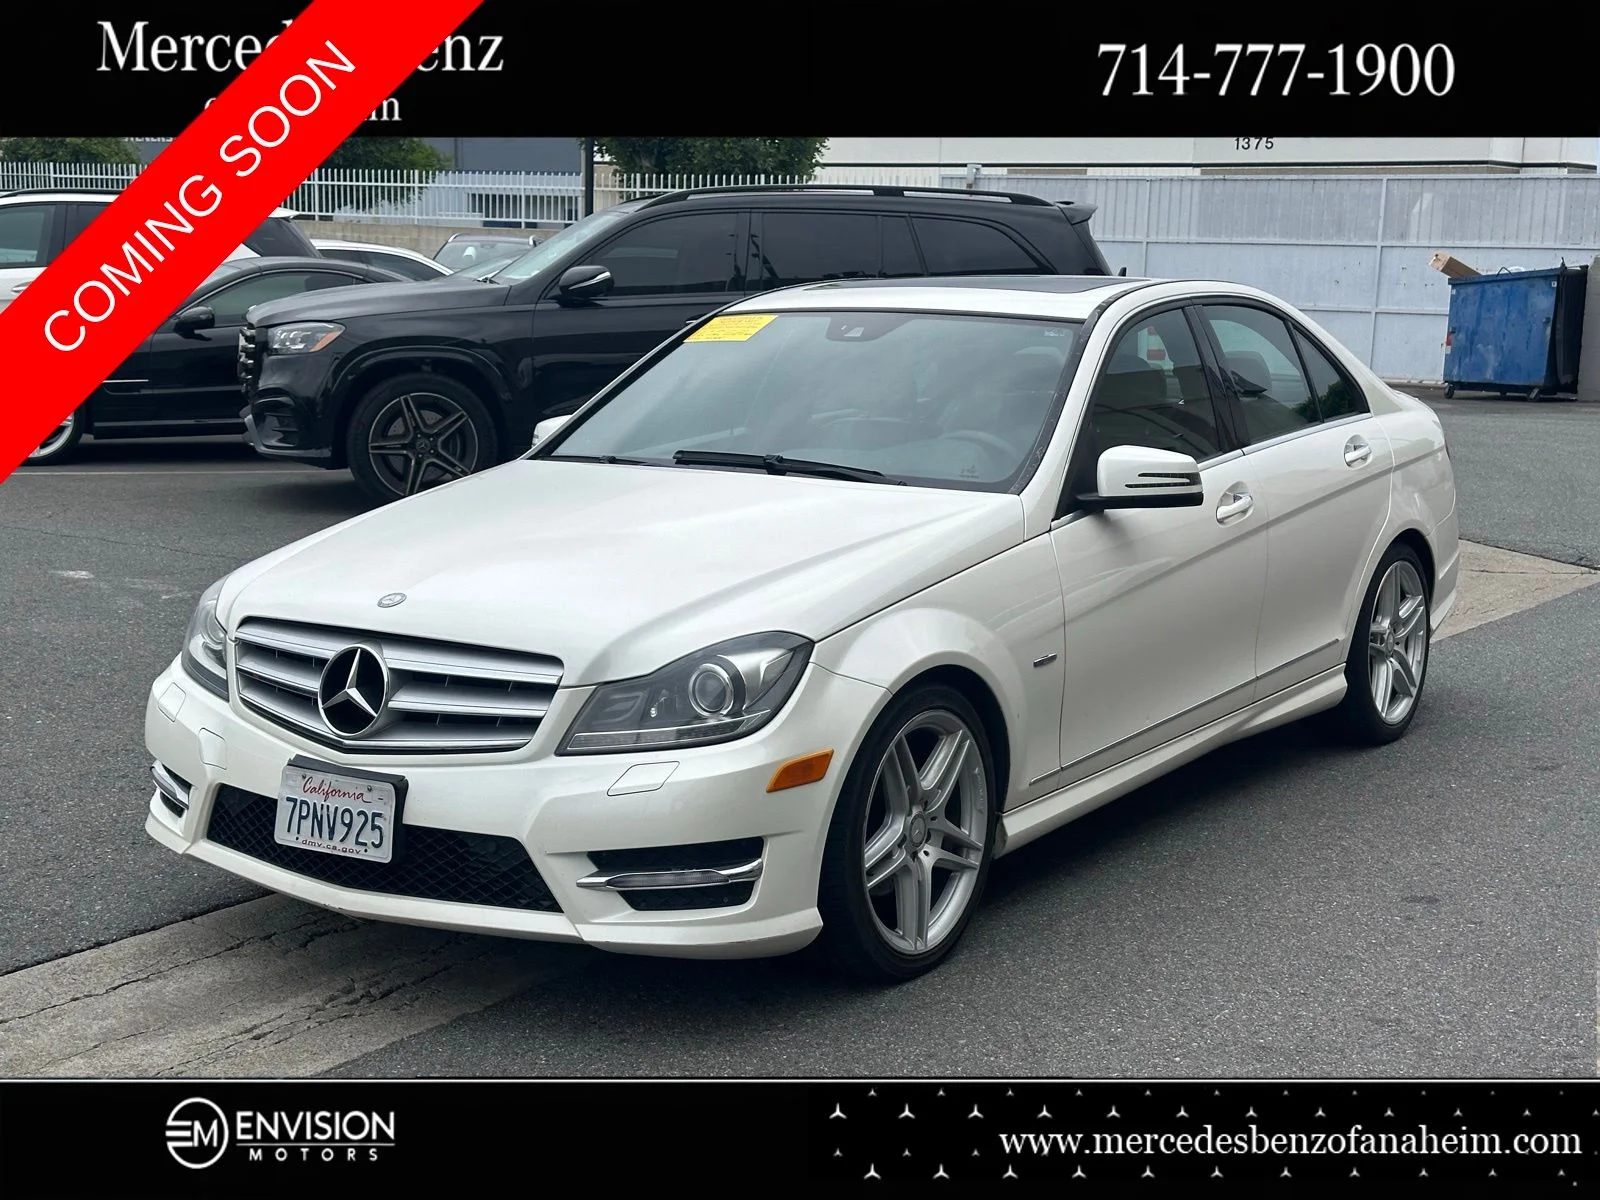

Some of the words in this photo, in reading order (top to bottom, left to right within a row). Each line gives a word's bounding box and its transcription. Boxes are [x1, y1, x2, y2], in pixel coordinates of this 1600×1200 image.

[1234, 137, 1274, 150] 1375
[302, 776, 372, 804] California
[285, 796, 385, 849] 7PNV925
[301, 839, 362, 855] dmv.ca.gov
